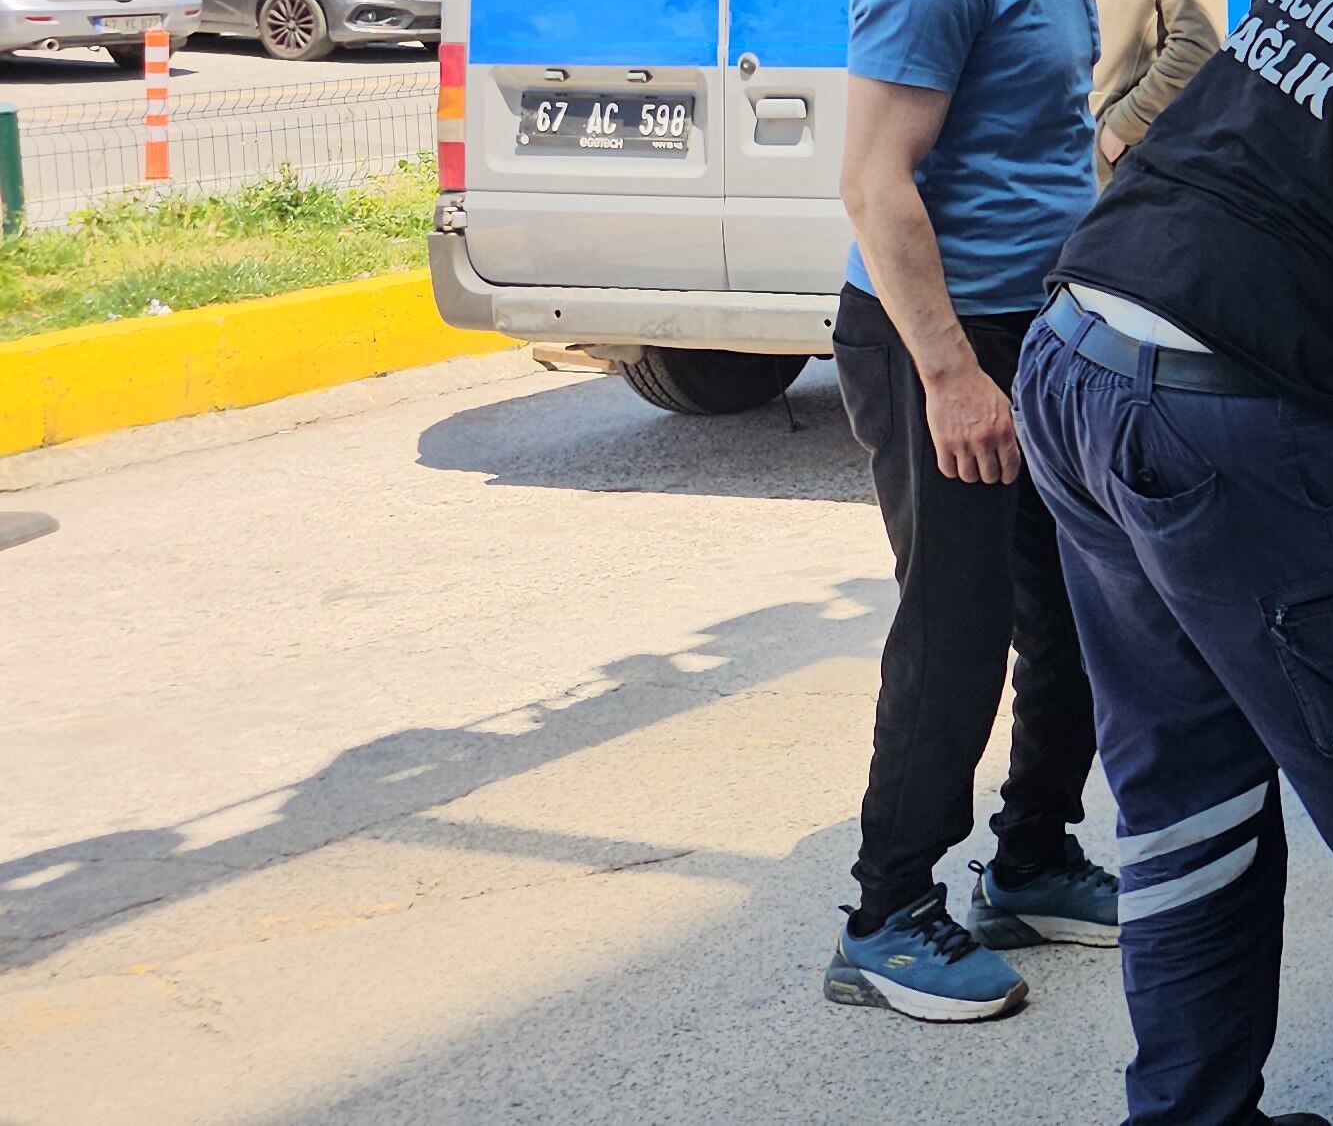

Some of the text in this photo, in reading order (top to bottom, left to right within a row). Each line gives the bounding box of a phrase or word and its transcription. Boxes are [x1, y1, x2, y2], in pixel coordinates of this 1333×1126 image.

[536, 101, 686, 138] 67 AC 598
